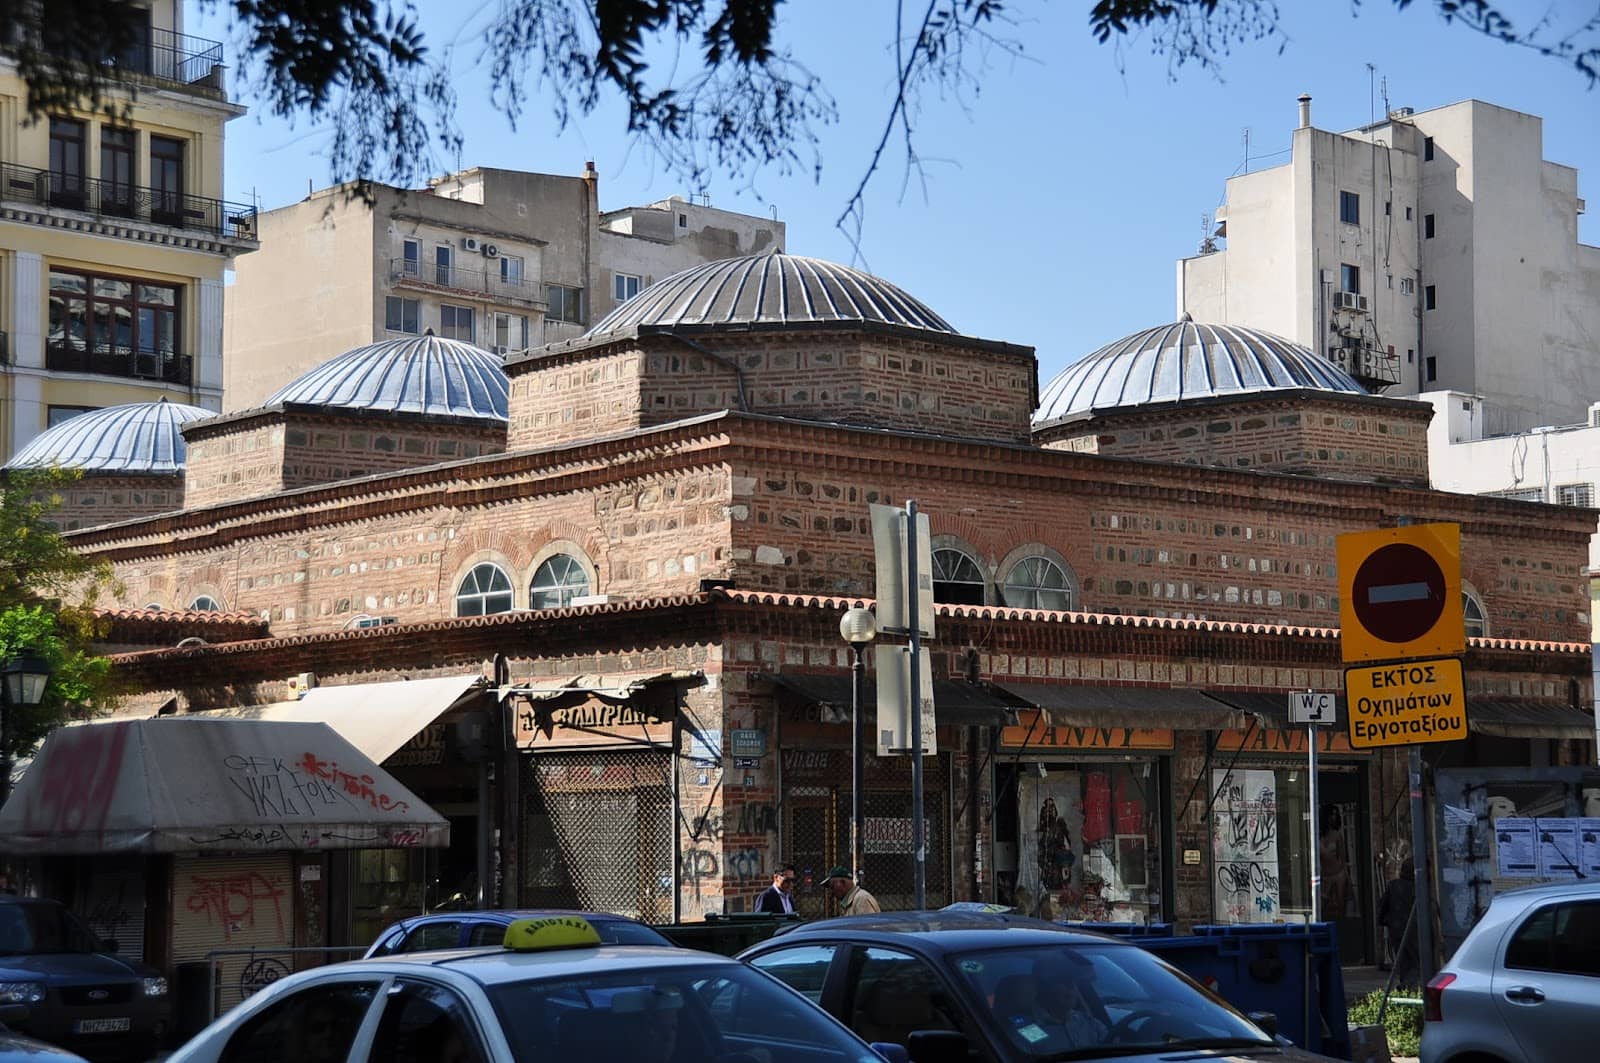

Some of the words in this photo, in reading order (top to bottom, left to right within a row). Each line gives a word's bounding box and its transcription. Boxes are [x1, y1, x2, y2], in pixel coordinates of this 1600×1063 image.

[1371, 666, 1436, 688] ΕΚΤΟΣ
[1357, 691, 1452, 718] Οχημάτων
[1354, 713, 1461, 741] Εργοταξίου
